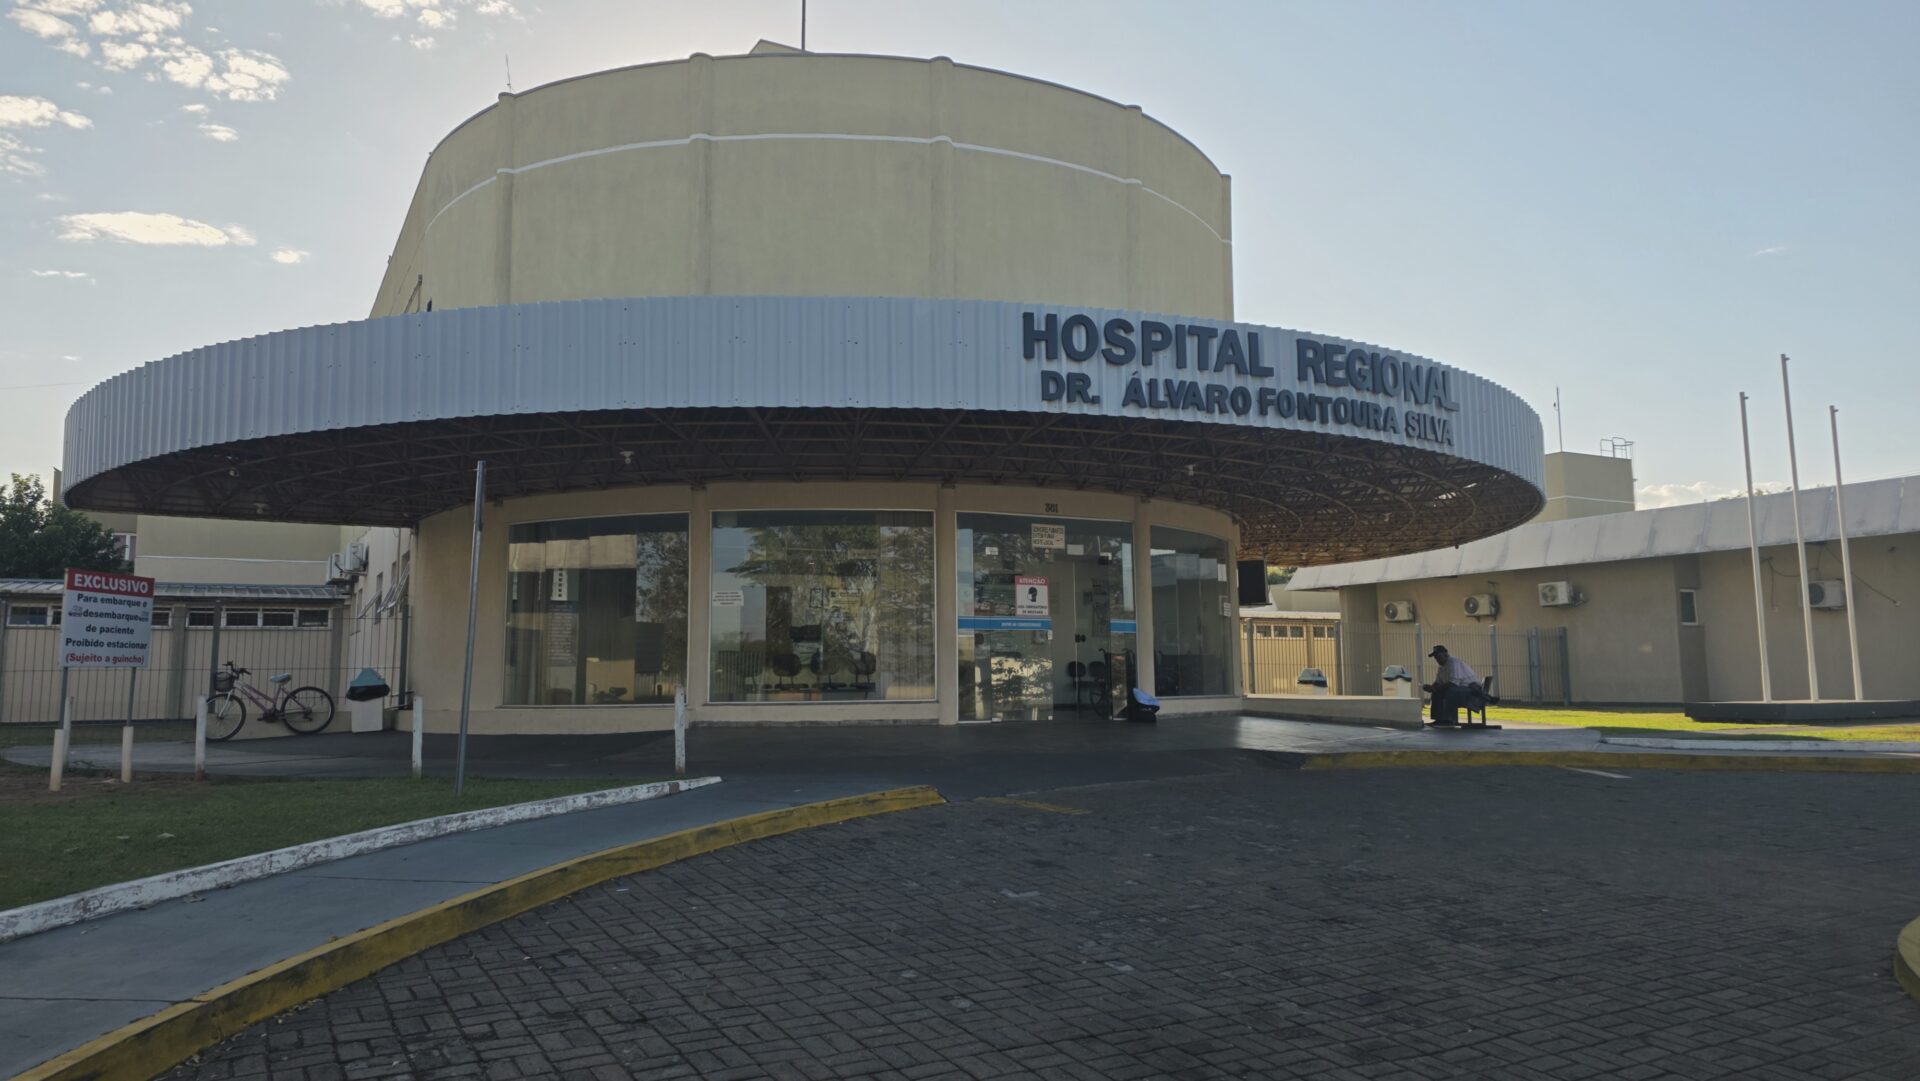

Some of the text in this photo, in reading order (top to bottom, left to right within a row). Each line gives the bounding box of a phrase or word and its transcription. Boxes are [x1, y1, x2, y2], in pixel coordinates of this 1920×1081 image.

[1023, 312, 1460, 411] HOSPITAL REGIONAL
[1041, 370, 1454, 446] DR. ÁLVARO FONTOURA SILVA
[74, 573, 148, 593] EXCLUSIVO
[77, 593, 148, 608] Para embarque e
[83, 609, 139, 622] desembarque
[85, 624, 134, 635] de paciente
[65, 638, 104, 648] Proibido
[65, 653, 102, 664] (Sujeito
[112, 655, 144, 664] guincho)
